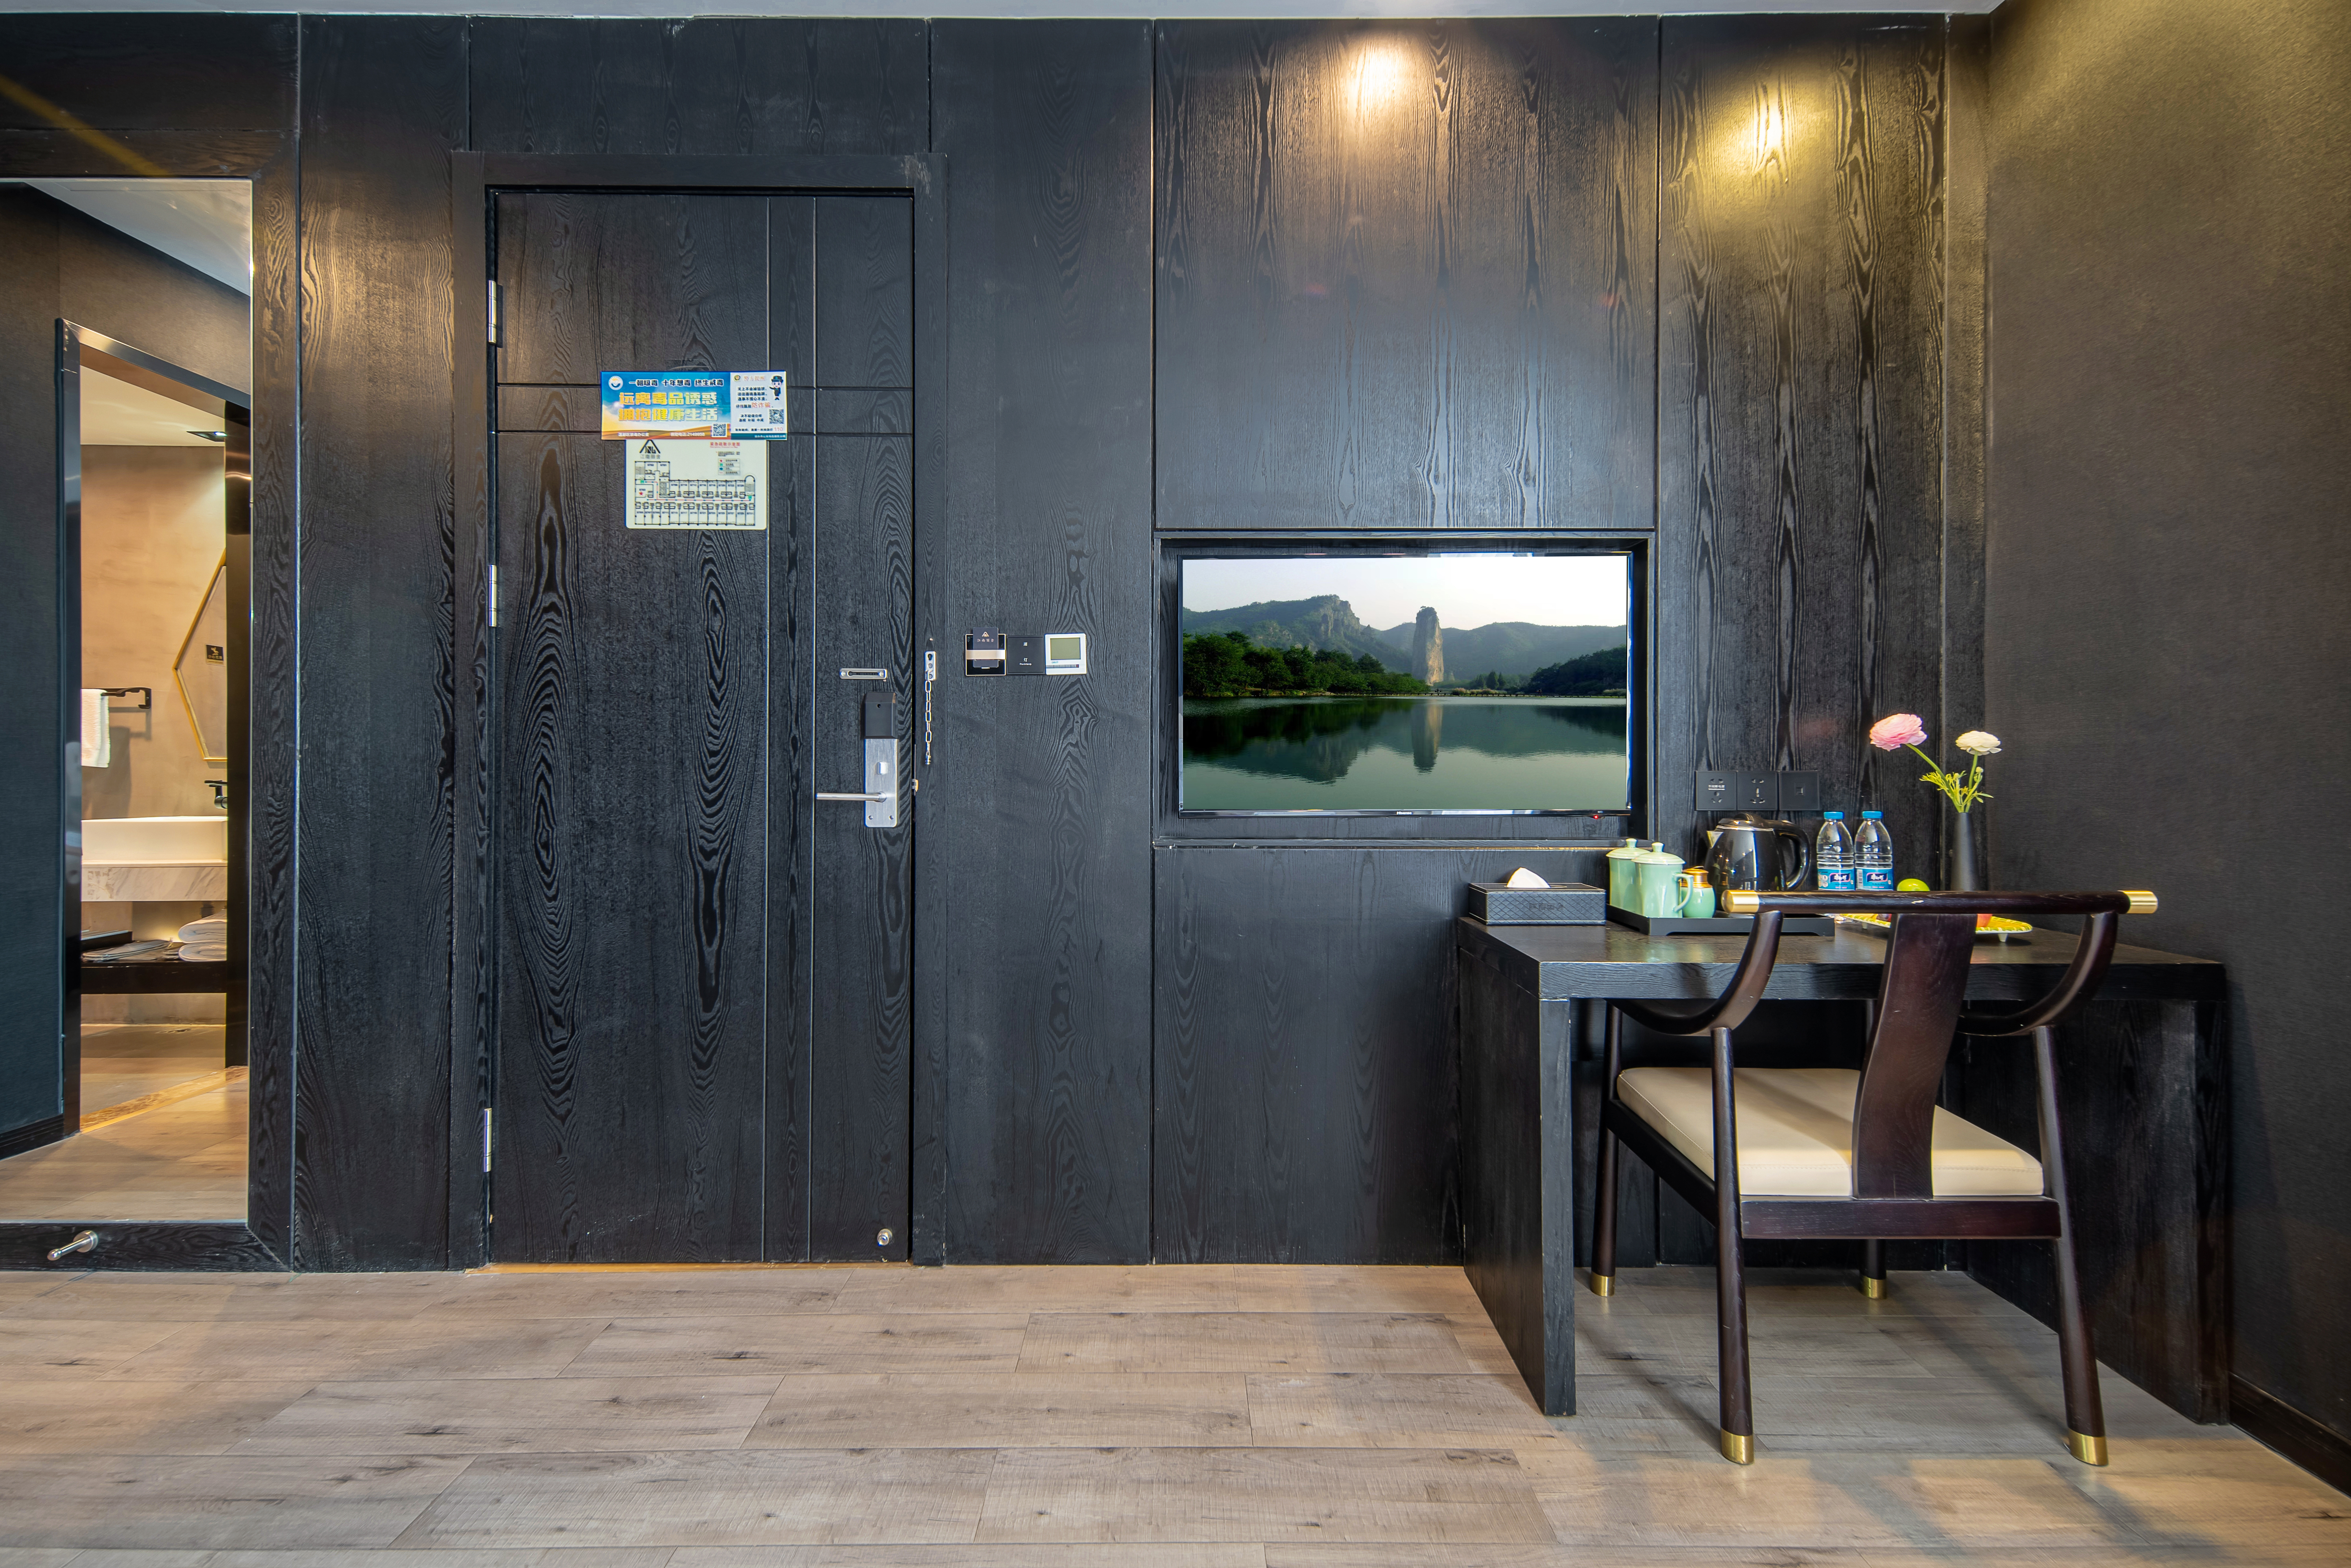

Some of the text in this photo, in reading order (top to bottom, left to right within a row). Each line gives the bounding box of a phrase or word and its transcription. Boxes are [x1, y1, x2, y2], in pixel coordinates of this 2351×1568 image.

[619, 392, 717, 405] 远离毒品诱惑
[618, 408, 717, 421] 拥抱健康生活
